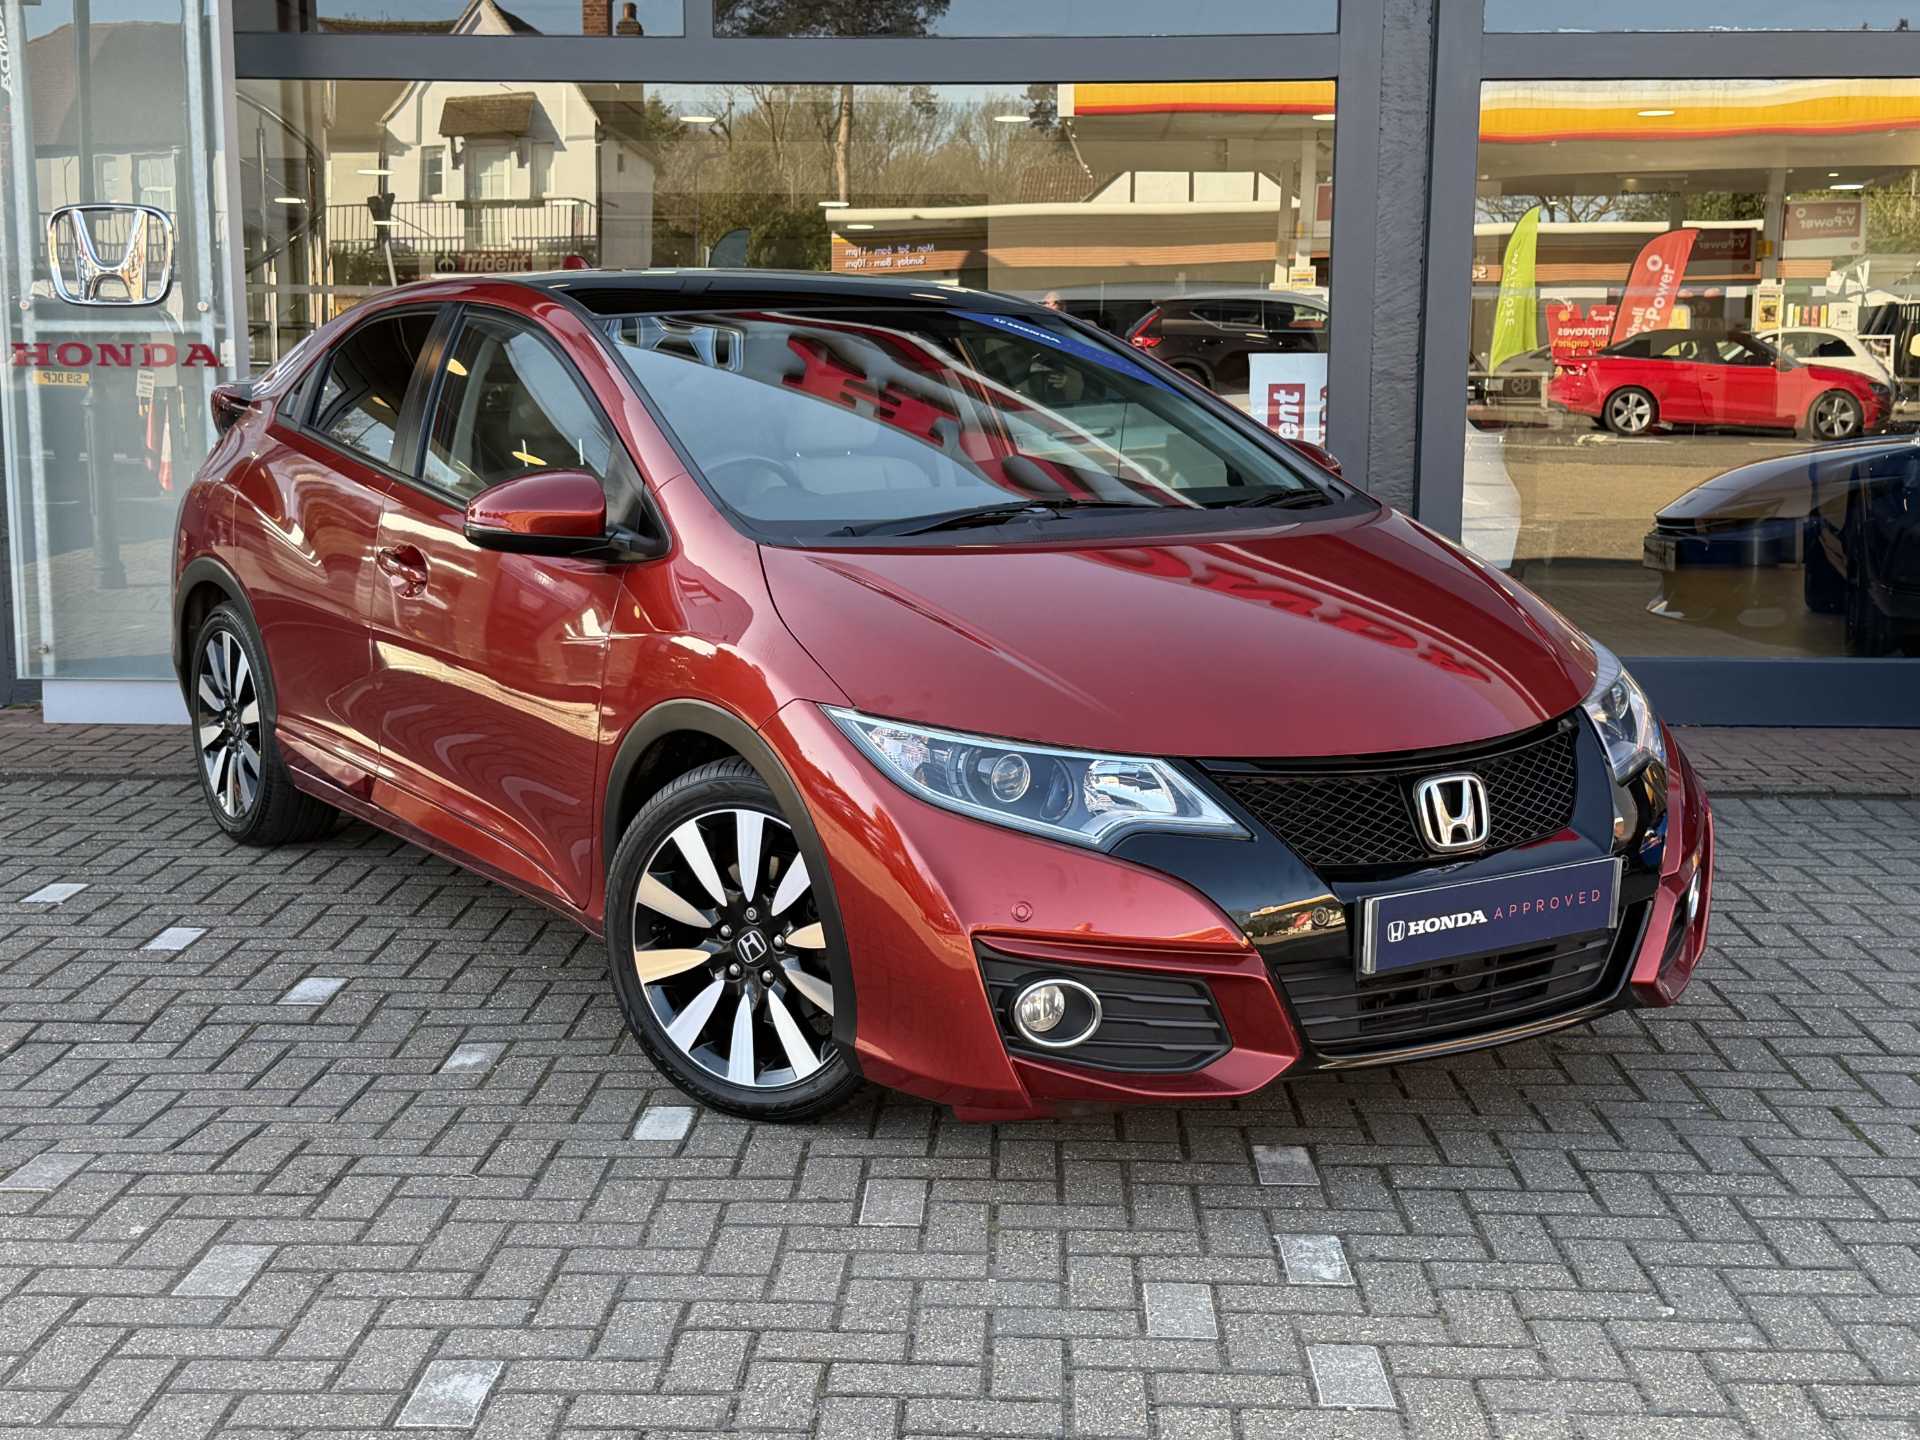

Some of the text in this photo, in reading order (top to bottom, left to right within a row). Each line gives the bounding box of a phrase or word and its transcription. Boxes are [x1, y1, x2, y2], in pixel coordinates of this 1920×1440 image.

[464, 253, 528, 272] Trident
[11, 342, 224, 368] HONDA
[1407, 889, 1601, 936] HONDA APPROVED
